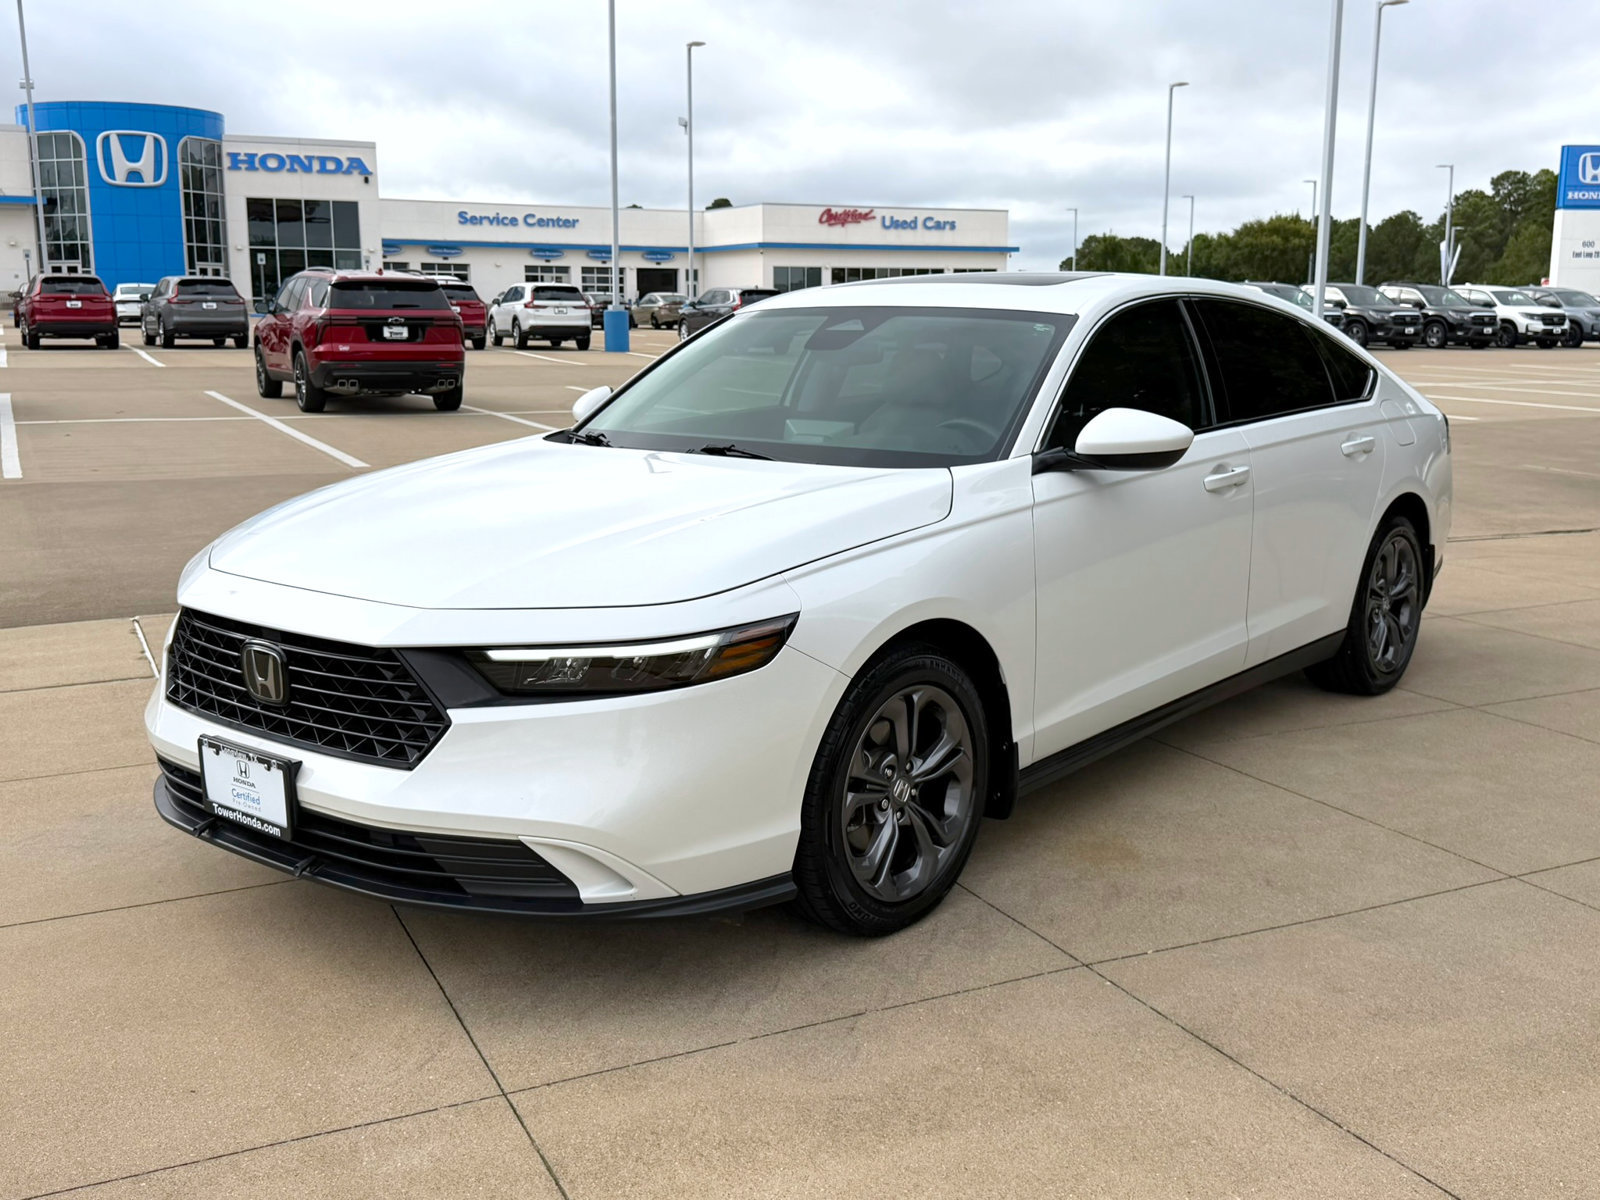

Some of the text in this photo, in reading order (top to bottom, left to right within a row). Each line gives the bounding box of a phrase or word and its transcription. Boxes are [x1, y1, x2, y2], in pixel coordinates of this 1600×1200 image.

[226, 152, 373, 176] HONDA
[1567, 191, 1600, 200] HON
[458, 211, 579, 228] Service Center
[882, 215, 918, 230] Used
[923, 216, 956, 231] Cars
[233, 776, 256, 789] HONDA
[231, 788, 261, 806] Certified
[212, 802, 281, 837] TowerHonda.com
